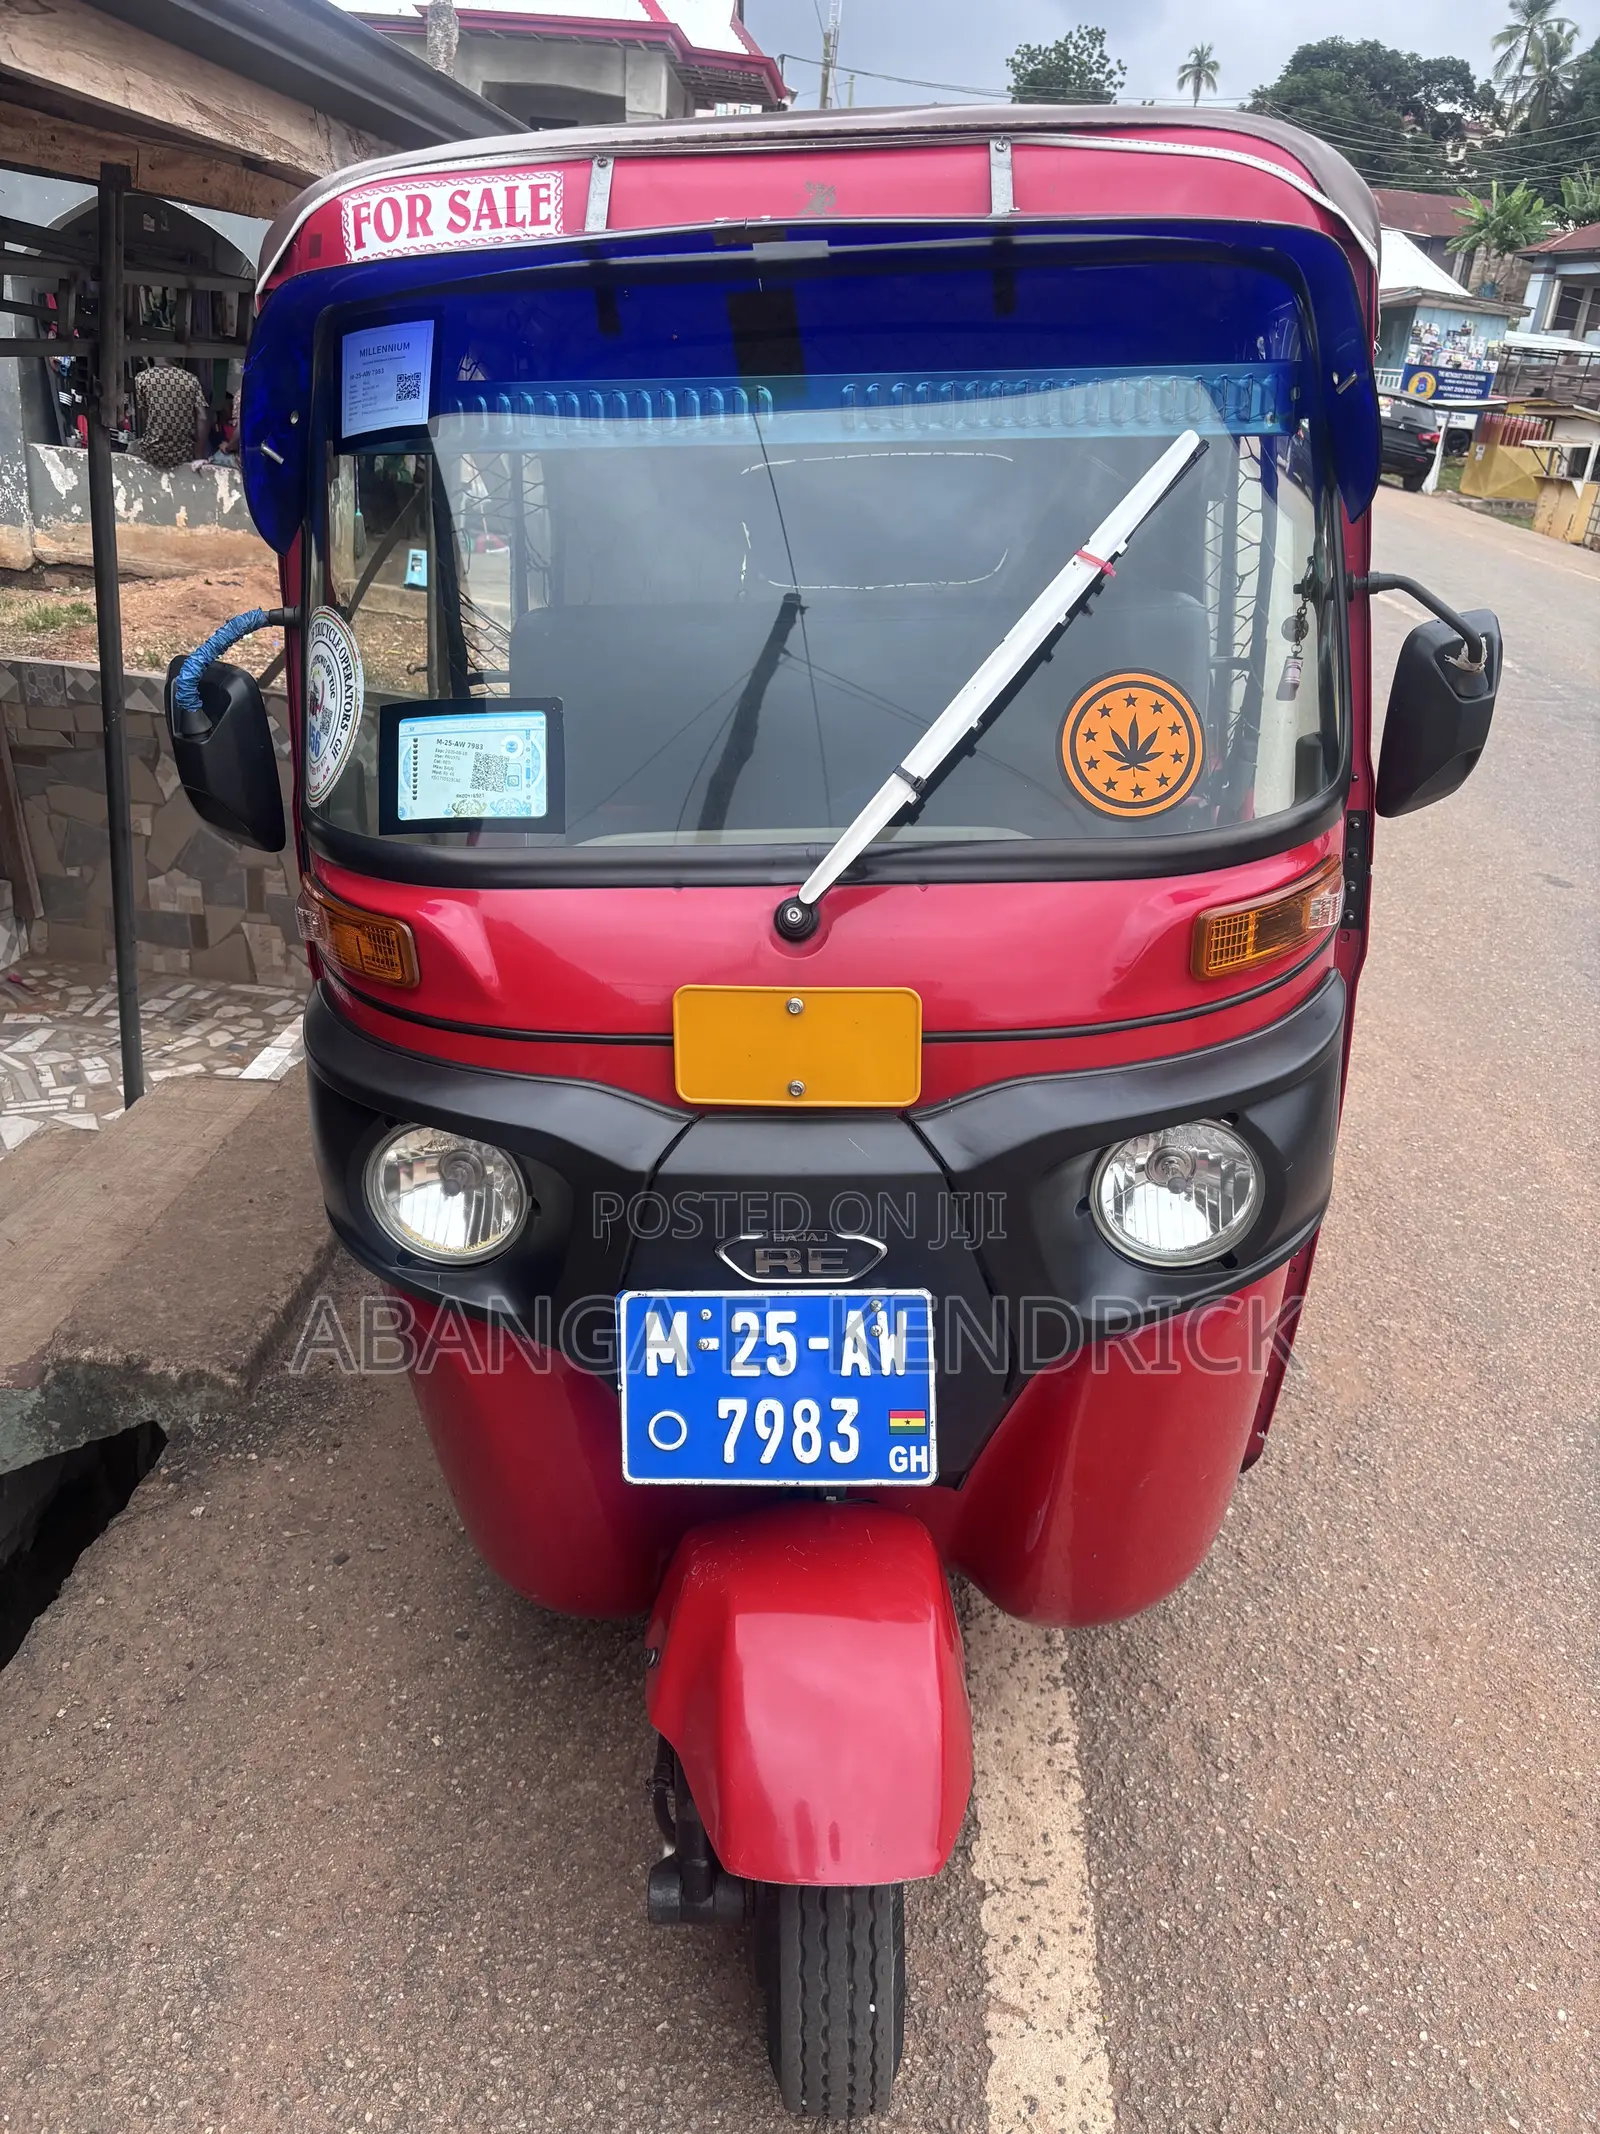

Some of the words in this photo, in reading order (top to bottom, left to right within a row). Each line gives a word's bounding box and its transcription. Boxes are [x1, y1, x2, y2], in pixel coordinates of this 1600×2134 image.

[351, 193, 434, 251] FOR
[446, 183, 552, 234] SALE
[359, 341, 410, 358] MILLENNIUM
[315, 621, 343, 651] TRICYCLE
[328, 675, 336, 699] TUC
[339, 647, 354, 732] OPERATORS
[331, 738, 343, 760] GH
[436, 738, 466, 748] M-25-AW
[467, 742, 484, 750] 7983
[773, 1232, 829, 1243] BAJAJ
[754, 1247, 849, 1274] RE
[717, 1397, 860, 1464] 7983
[888, 1444, 928, 1473] GH
